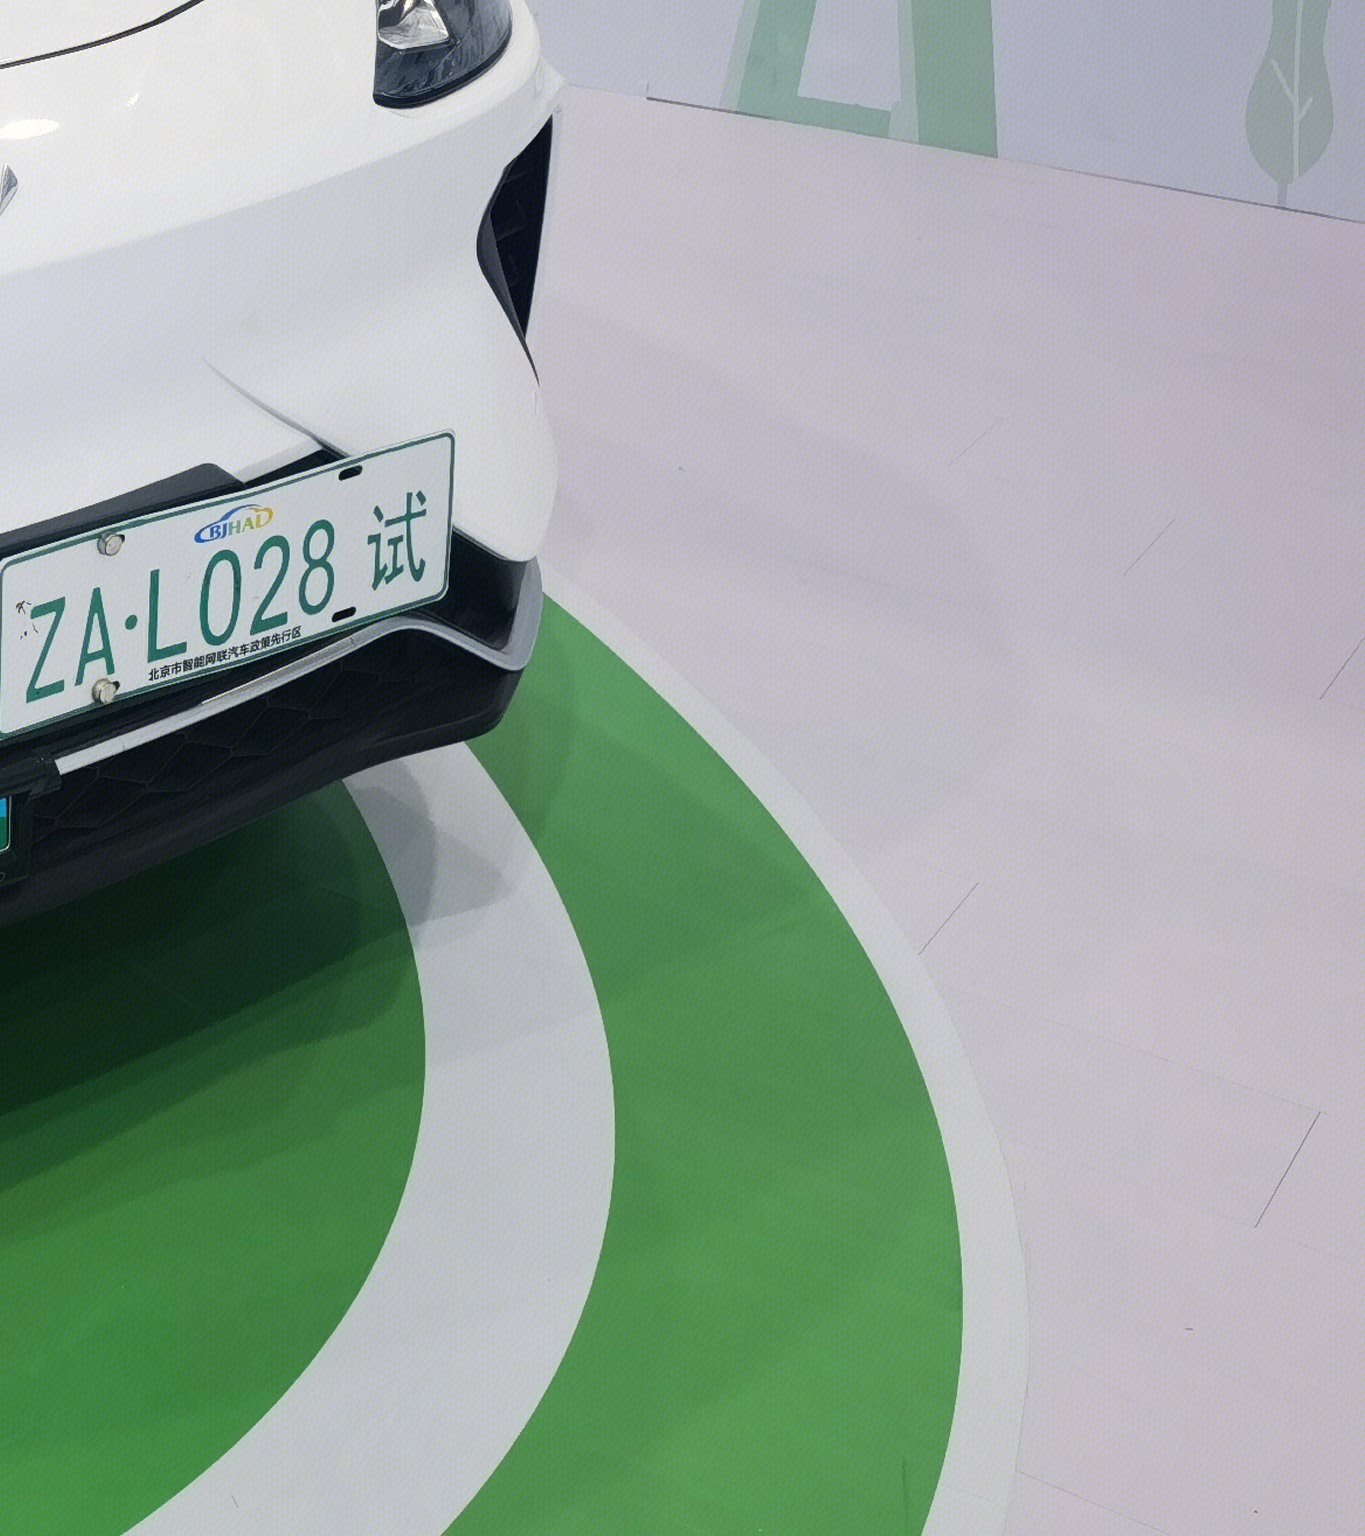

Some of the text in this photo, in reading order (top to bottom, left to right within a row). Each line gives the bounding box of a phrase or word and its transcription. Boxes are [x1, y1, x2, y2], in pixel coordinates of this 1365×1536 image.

[367, 490, 427, 591] 试
[147, 624, 303, 682] 北京市智能网联汽车政策先行区
